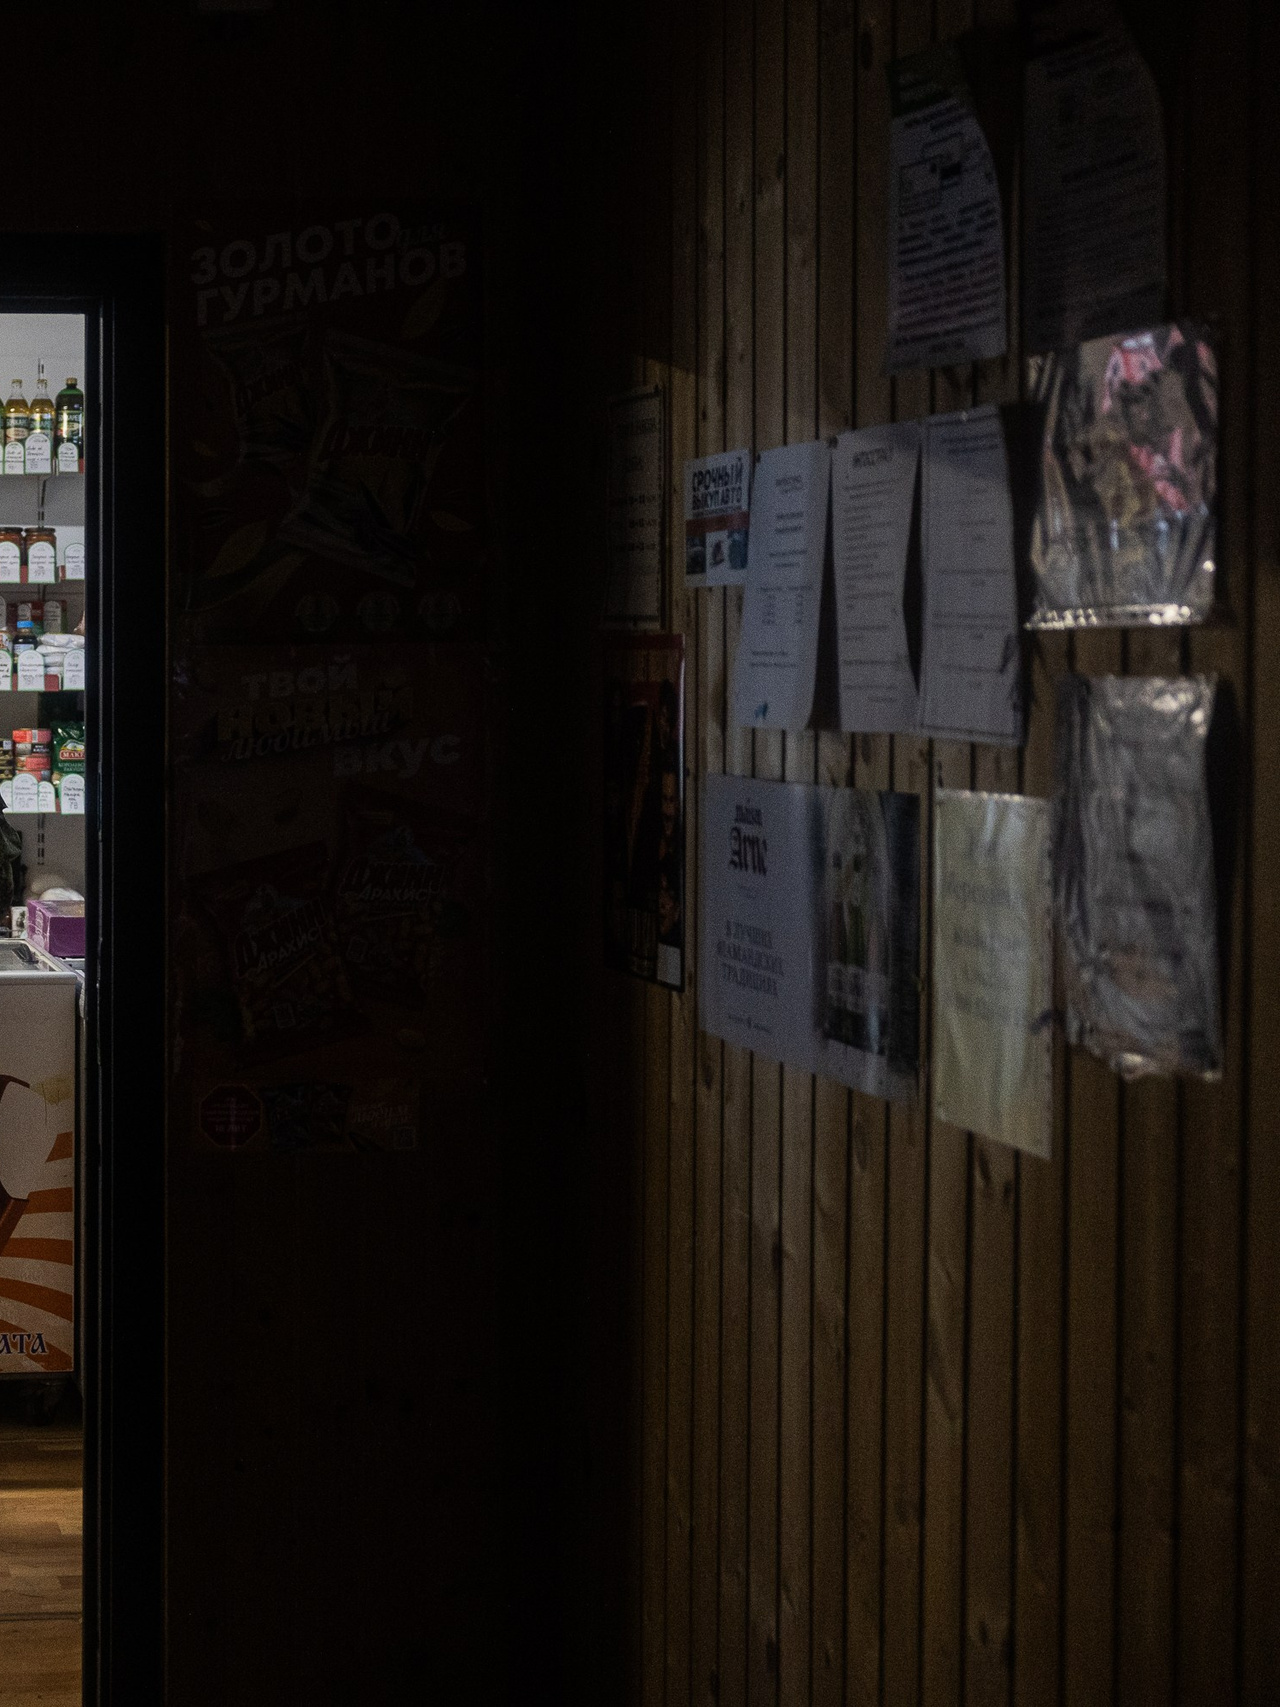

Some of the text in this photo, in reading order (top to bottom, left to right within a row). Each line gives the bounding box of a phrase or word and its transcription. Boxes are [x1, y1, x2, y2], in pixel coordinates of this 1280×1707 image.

[191, 212, 401, 285] ЗОЛОТО
[195, 241, 467, 327] ГУРМАНОВ
[692, 455, 743, 492] СРОЧНЫЙ
